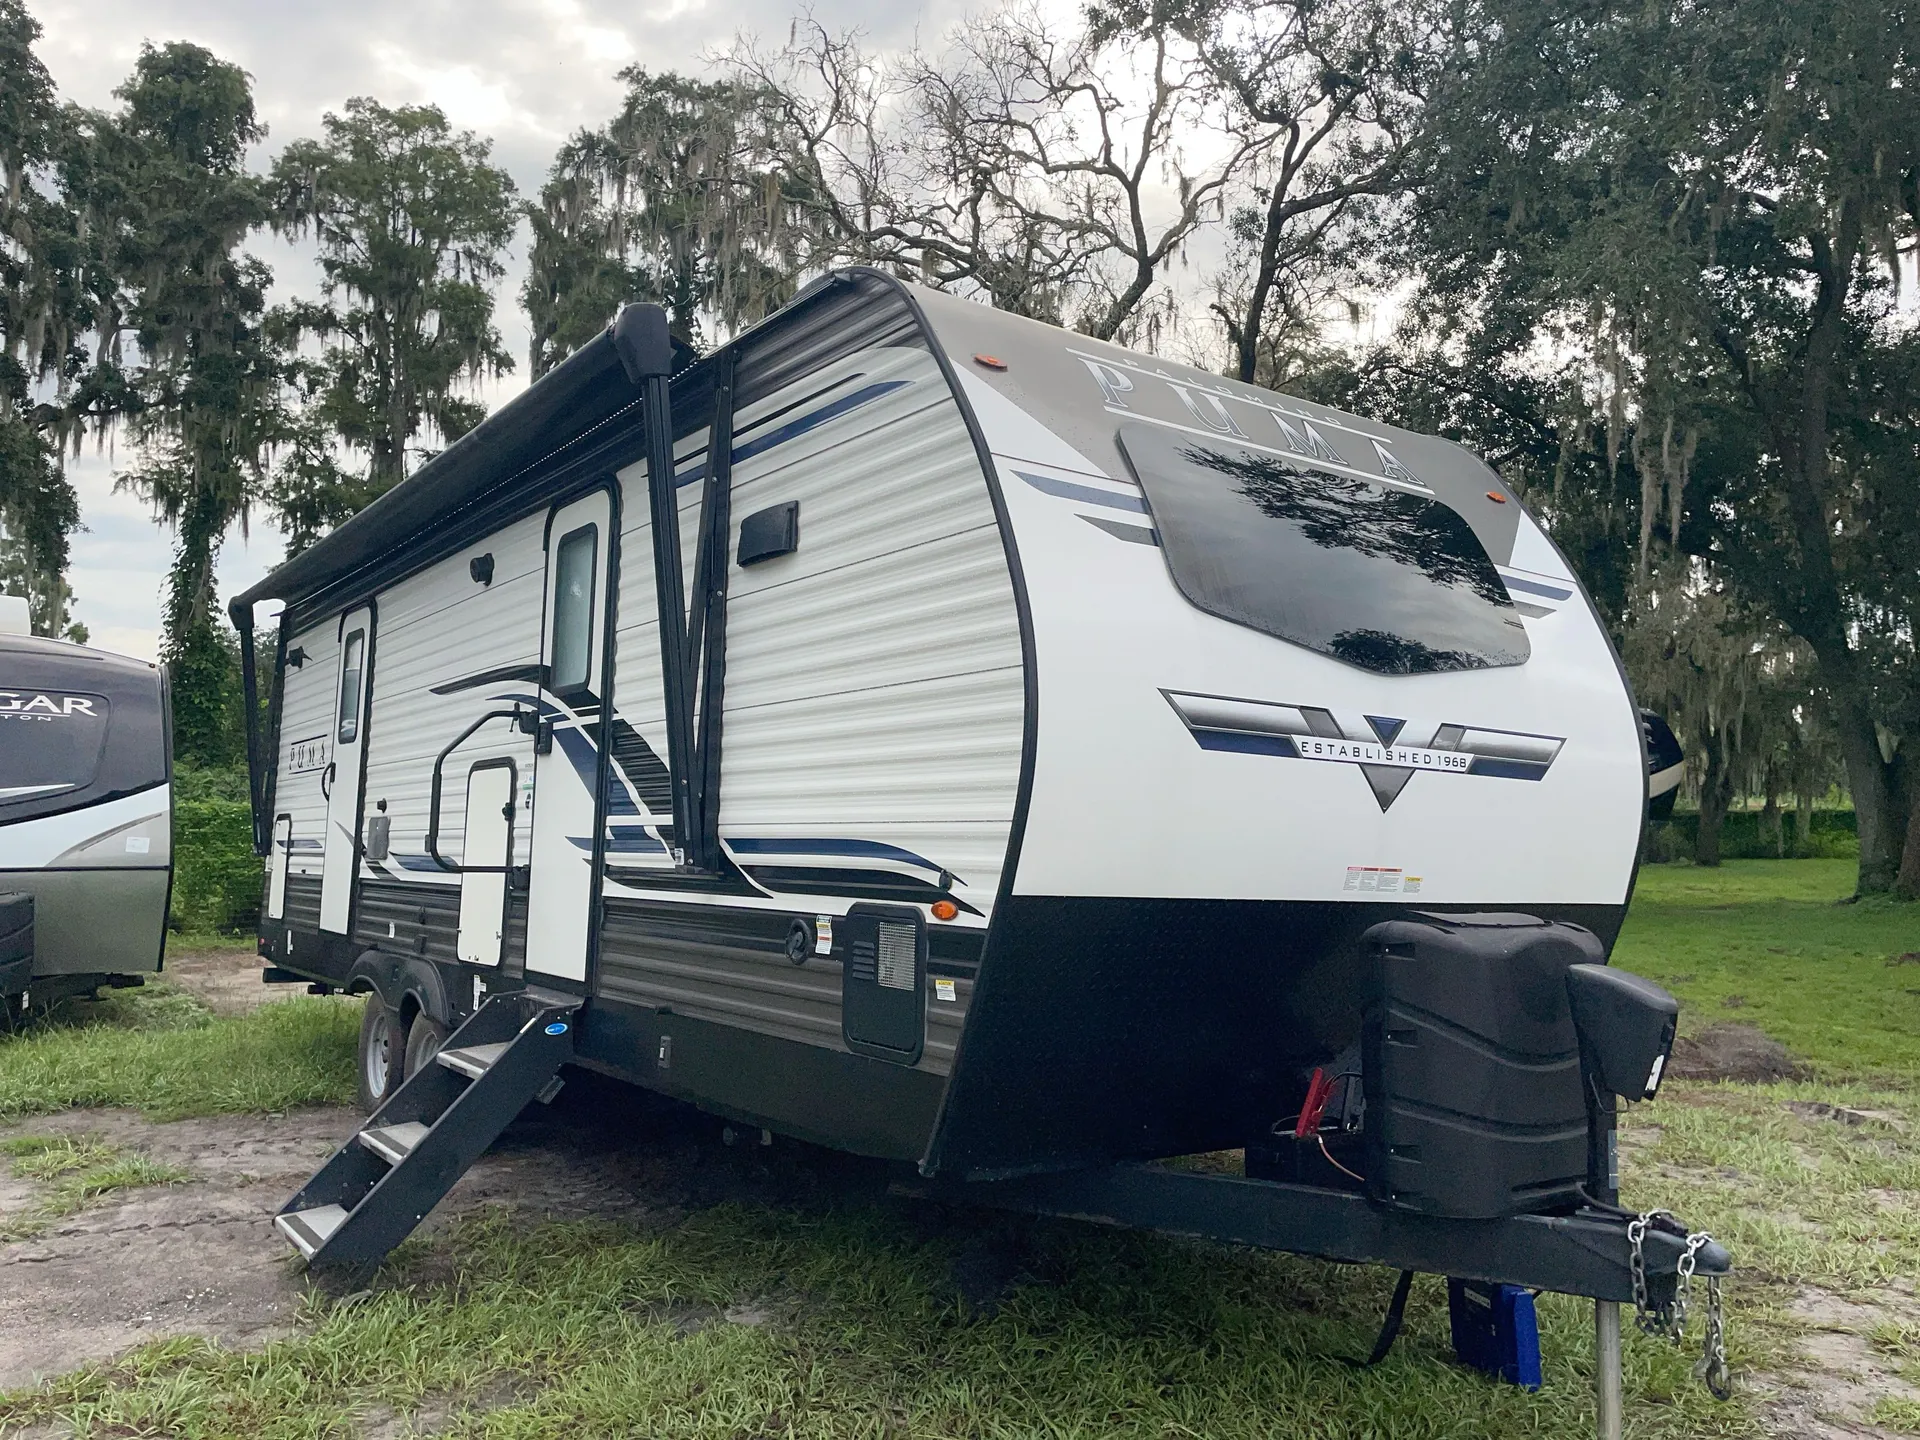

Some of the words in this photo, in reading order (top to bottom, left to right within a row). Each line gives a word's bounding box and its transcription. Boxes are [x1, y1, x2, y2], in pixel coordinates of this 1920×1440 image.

[1123, 358, 1341, 426] PALOMINO
[1077, 357, 1426, 487] PUMA
[289, 740, 326, 770] PUMA
[1301, 741, 1432, 765] ESTABLISHED
[1437, 754, 1467, 768] 1968
